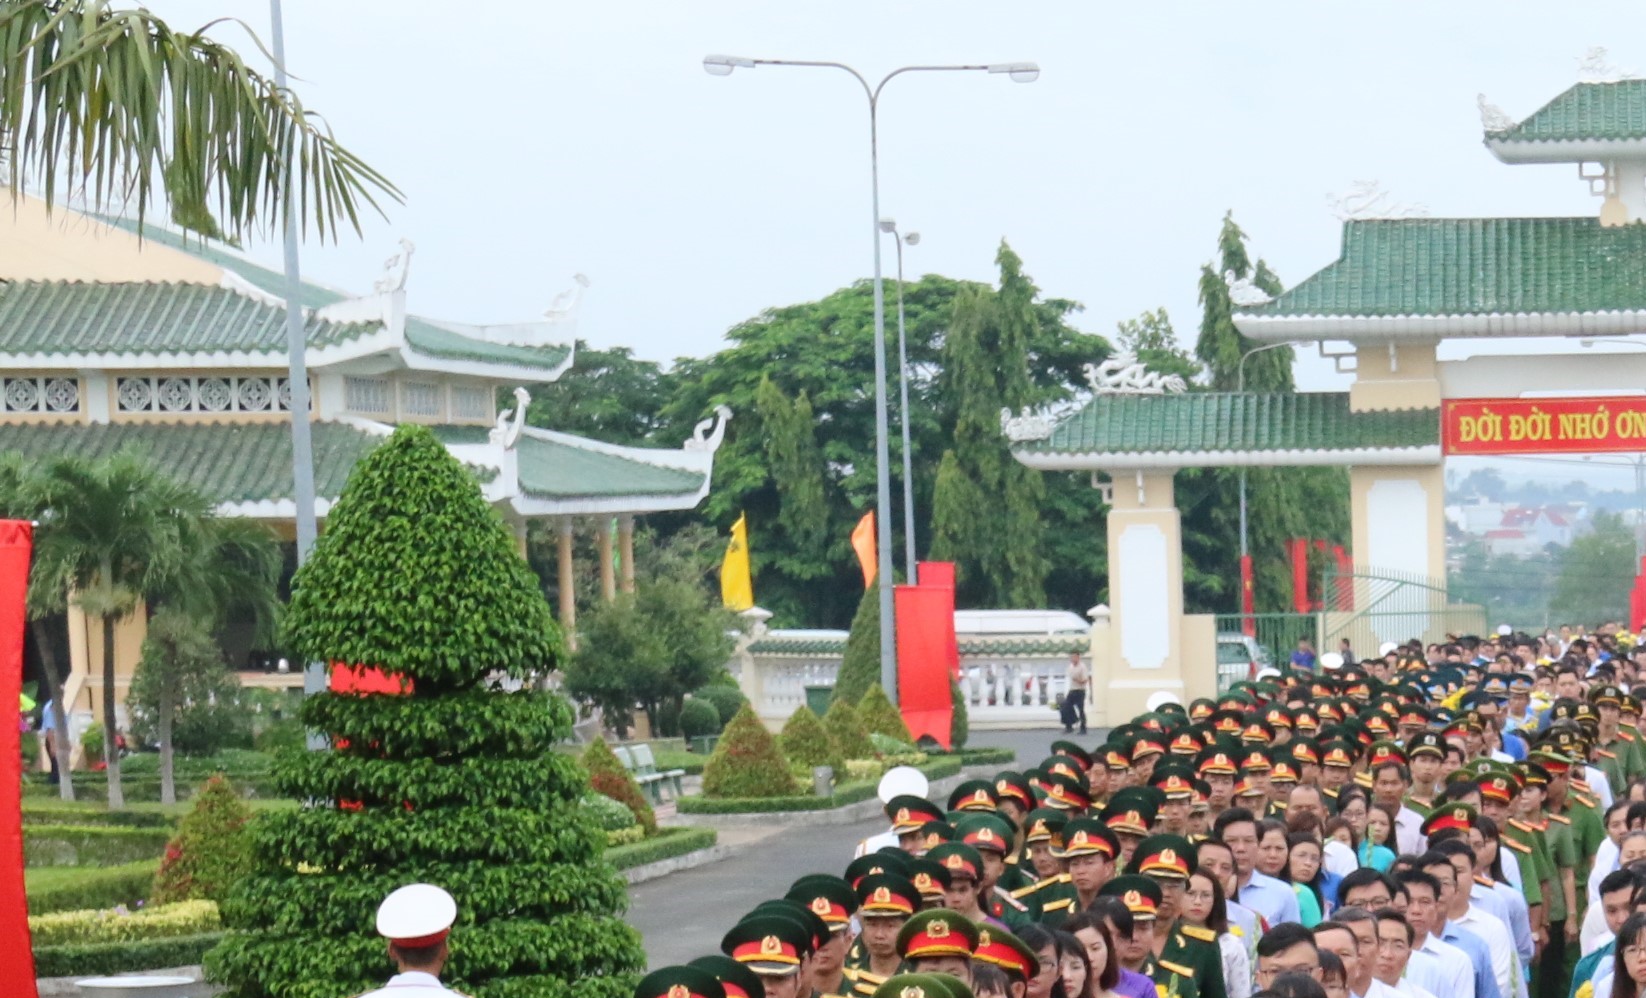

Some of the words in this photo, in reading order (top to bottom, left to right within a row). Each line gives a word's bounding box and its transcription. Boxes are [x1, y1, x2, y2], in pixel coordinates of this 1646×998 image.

[1459, 407, 1503, 442] ĐỜI
[1508, 406, 1552, 441] ĐỜI
[1558, 404, 1611, 441] NHỚ
